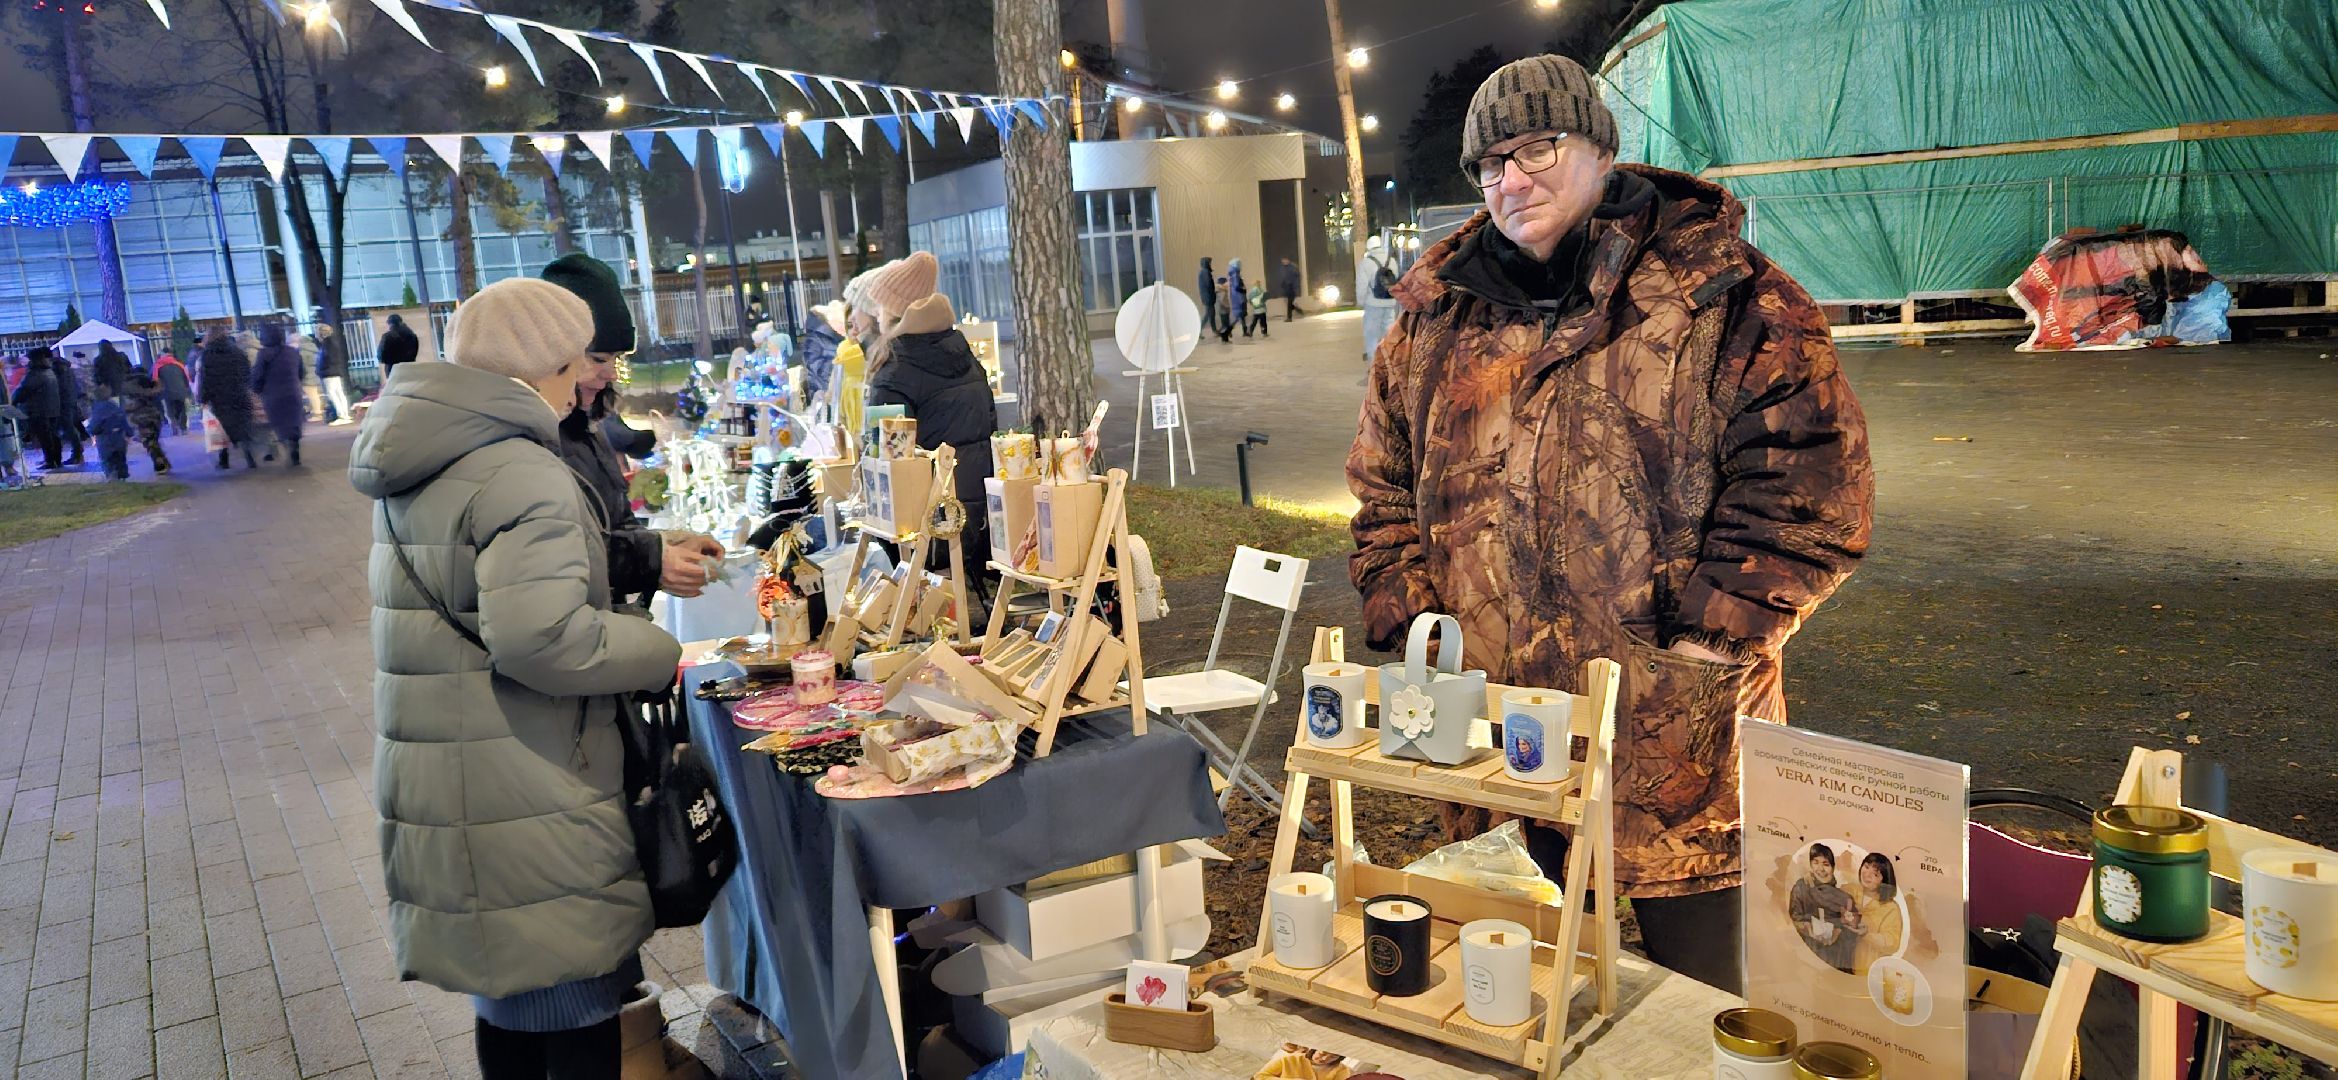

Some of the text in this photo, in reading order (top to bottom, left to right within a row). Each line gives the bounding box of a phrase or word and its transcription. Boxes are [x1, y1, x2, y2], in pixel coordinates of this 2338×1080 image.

[1754, 749, 1950, 802] ароматических свечей ручной работы
[1792, 747, 1905, 780] Семейная мастерская
[1775, 766, 1925, 812] VERA KIM CANDLES
[1827, 796, 1874, 814] сумочках
[1757, 825, 1791, 840] ТАТЬЯНА
[1920, 862, 1944, 875] ВЕРА
[1781, 1002, 1799, 1013] нас
[1799, 1008, 1849, 1034] ароматно,
[1850, 1026, 1882, 1045] уютно
[1884, 1041, 1891, 1049] и
